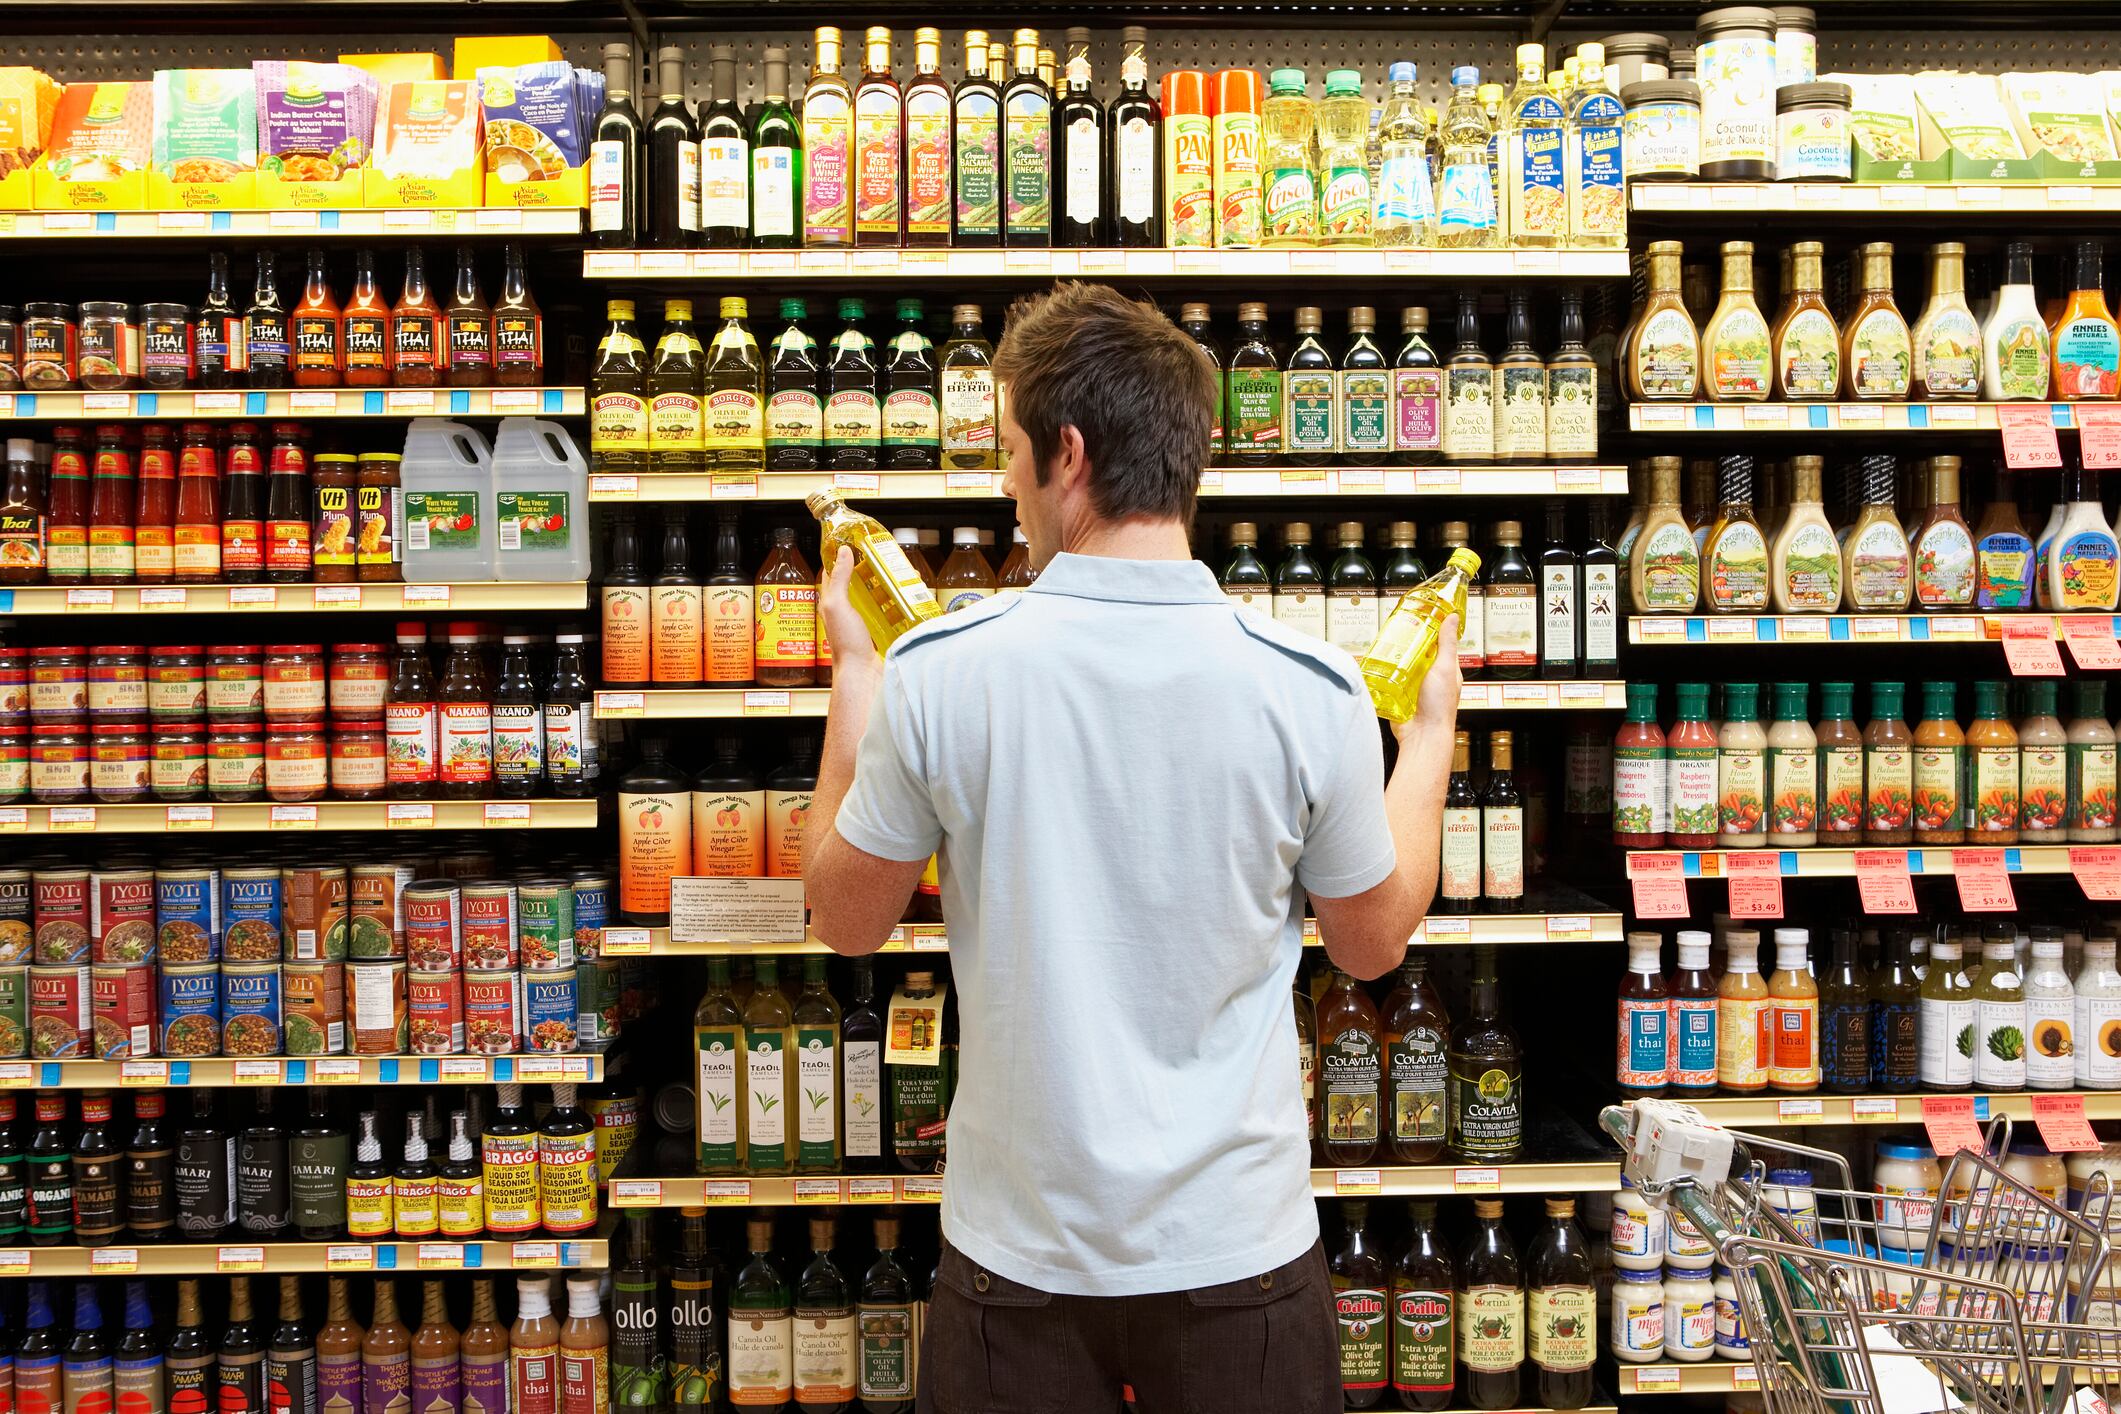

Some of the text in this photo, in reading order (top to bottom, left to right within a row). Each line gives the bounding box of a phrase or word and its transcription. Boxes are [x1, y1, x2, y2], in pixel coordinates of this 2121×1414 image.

[314, 111, 342, 119] Chicken
[1716, 122, 1757, 135] Coconut
[1798, 144, 1838, 155] Coconut
[815, 153, 839, 161] Organic
[965, 151, 989, 159] Organic
[813, 161, 840, 169] WHITE
[870, 158, 887, 166] RED
[960, 158, 993, 167] BALSAMIC
[962, 166, 992, 175] VINEGAR
[182, 192, 202, 200] Home
[1228, 190, 1260, 204] ORIGINAL
[1267, 175, 1310, 209] Crisco
[147, 334, 183, 347] THAI
[498, 332, 534, 345] THAI
[599, 396, 636, 408] BORGES
[713, 393, 750, 405] BORGES
[836, 392, 870, 404] BORGES
[2029, 452, 2057, 461] $5.00
[323, 511, 345, 520] Plum
[2, 517, 32, 529] Thai
[779, 589, 816, 600] BRAGG
[1495, 586, 1527, 594] Spectrum
[1490, 602, 1532, 610] Peanut Oil
[2031, 662, 2059, 670] $5.00
[1681, 773, 1710, 781] Raspberry
[1730, 768, 1752, 777] Honey
[1680, 782, 1711, 790] Vinaigrette
[1727, 777, 1756, 785] Mustard
[1727, 785, 1755, 793] Dressing
[628, 797, 673, 809] Omega Nutrition
[633, 837, 671, 845] Apple Cider
[40, 884, 81, 899] JYOTi
[231, 883, 272, 897] JYOTi
[466, 900, 499, 915] JYOTi
[535, 983, 570, 997] JYOTi
[1639, 1037, 1662, 1049] thai
[1781, 1035, 1805, 1046] thai
[1326, 1054, 1378, 1067] COLAVITA
[1469, 1103, 1517, 1116] COLAVITA
[485, 1150, 534, 1164] BRAGG
[292, 1166, 336, 1175] TAMARI
[489, 1171, 513, 1179] LIQUID
[489, 1178, 530, 1187] SEASONING
[76, 1190, 117, 1201] TAMARI
[398, 1186, 432, 1196] BRAGG
[511, 1194, 536, 1204] LIQUIDE
[1694, 1205, 1717, 1226] MARKET
[1400, 1300, 1446, 1316] Gallo
[737, 1335, 777, 1344] Canola Oil
[732, 1342, 784, 1351] Huile de canola
[1400, 1344, 1447, 1354] Extra Virgin
[1409, 1353, 1429, 1362] Olive
[1401, 1361, 1446, 1370] Huile d'olive
[172, 1374, 204, 1385] TAMARI
[1403, 1370, 1444, 1379] extra vierge
[525, 1383, 549, 1395] thai
